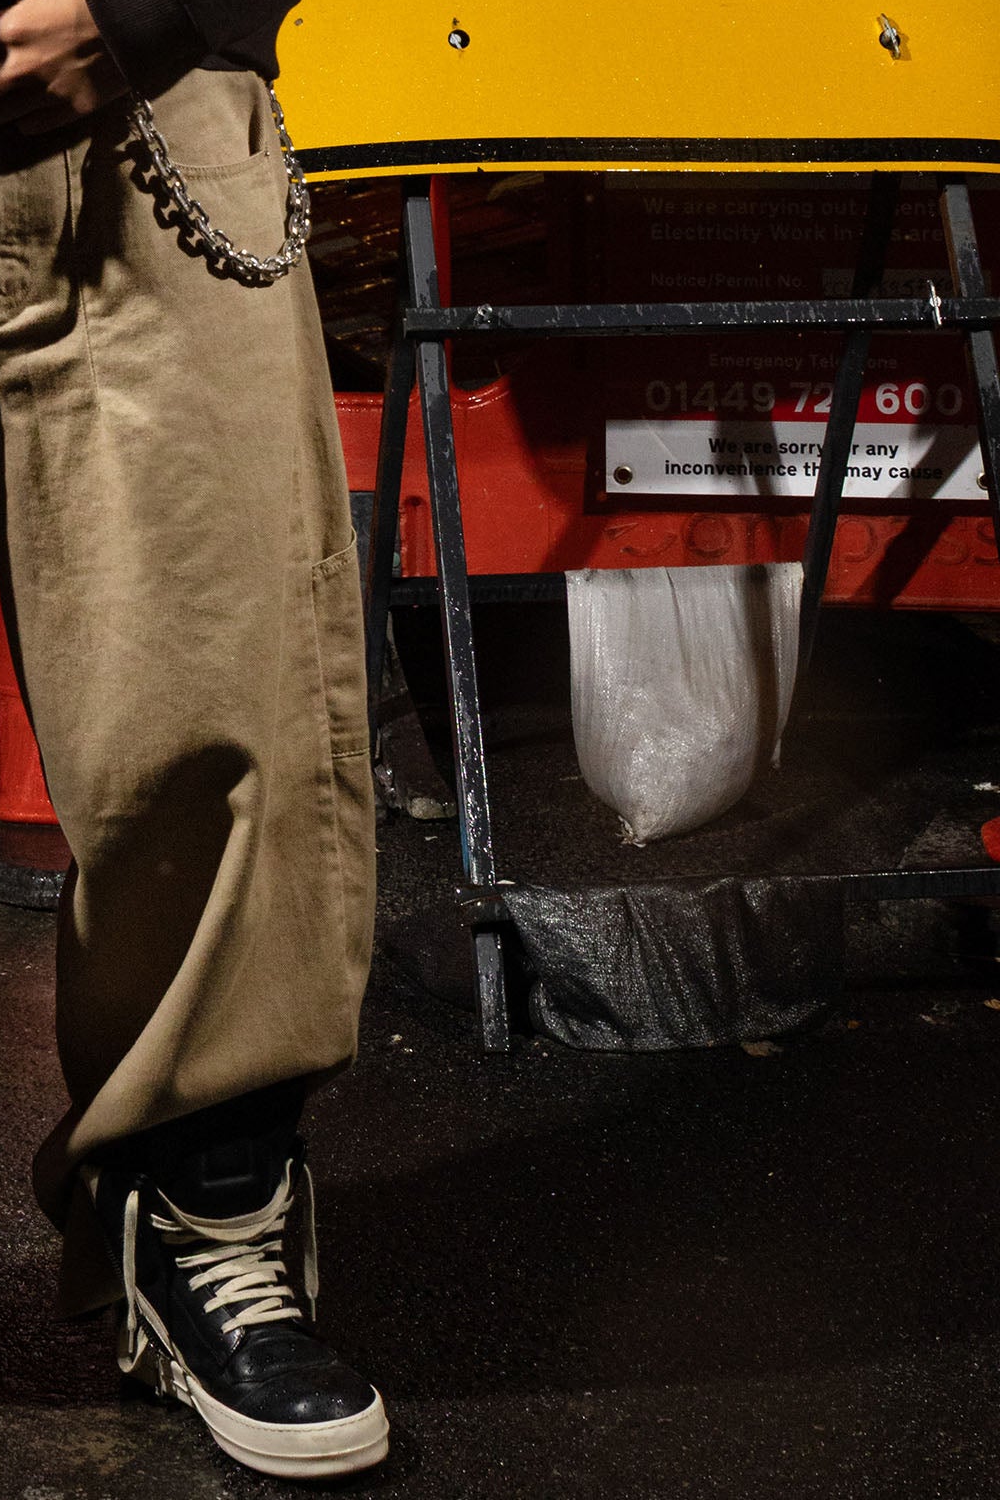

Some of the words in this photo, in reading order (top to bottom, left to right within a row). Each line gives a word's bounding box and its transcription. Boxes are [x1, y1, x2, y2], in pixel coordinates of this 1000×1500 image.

[644, 198, 677, 216] We
[684, 202, 716, 216] are
[724, 199, 812, 221] carrying
[822, 200, 857, 217] out
[649, 222, 762, 244] Electricity
[770, 223, 826, 242] Work
[833, 223, 854, 242] in
[908, 227, 944, 242] are
[650, 272, 771, 290] Notice/Permit
[708, 353, 803, 371] Emergency
[809, 353, 898, 369] Telone
[645, 379, 776, 414] 01449
[790, 381, 834, 414] 72
[875, 381, 964, 417] 600
[709, 437, 737, 454] We
[743, 440, 773, 455] are
[779, 441, 823, 458] sorry
[865, 443, 899, 459] any
[665, 458, 797, 477] inconvenience
[845, 465, 882, 481] may
[888, 466, 944, 480] cause
